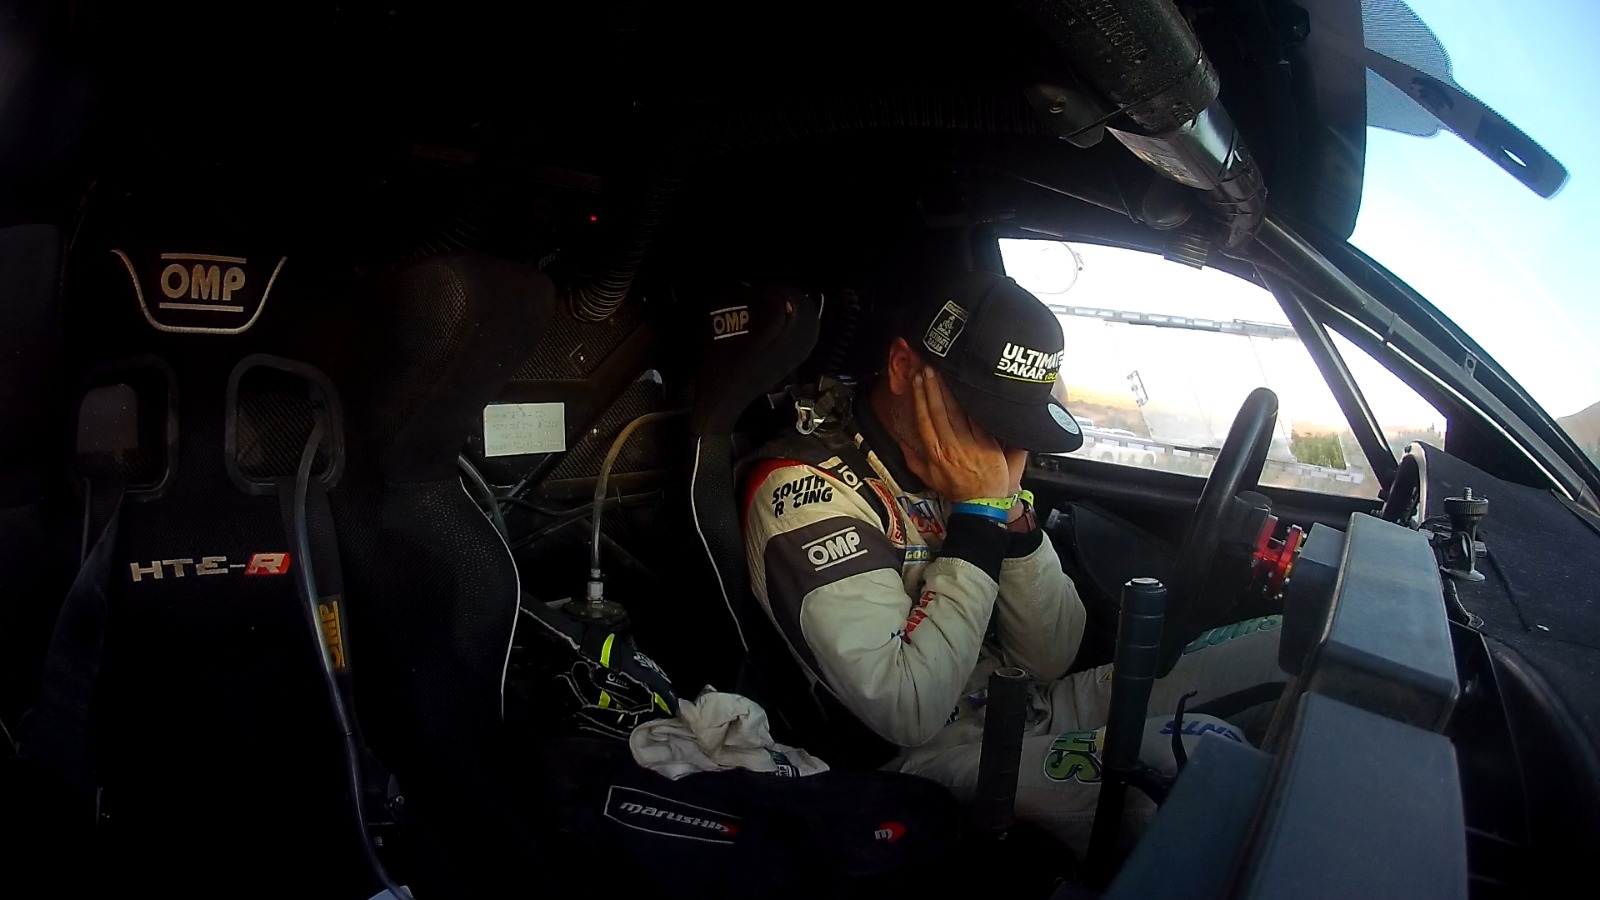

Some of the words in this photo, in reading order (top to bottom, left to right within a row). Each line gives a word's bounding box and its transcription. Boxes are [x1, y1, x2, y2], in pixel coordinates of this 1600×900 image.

[160, 263, 246, 301] OMP
[712, 310, 750, 334] OMP
[997, 358, 1046, 380] DAKAR
[771, 475, 826, 505] SOUTH
[806, 530, 861, 566] OMP
[129, 553, 288, 582] HTE-R
